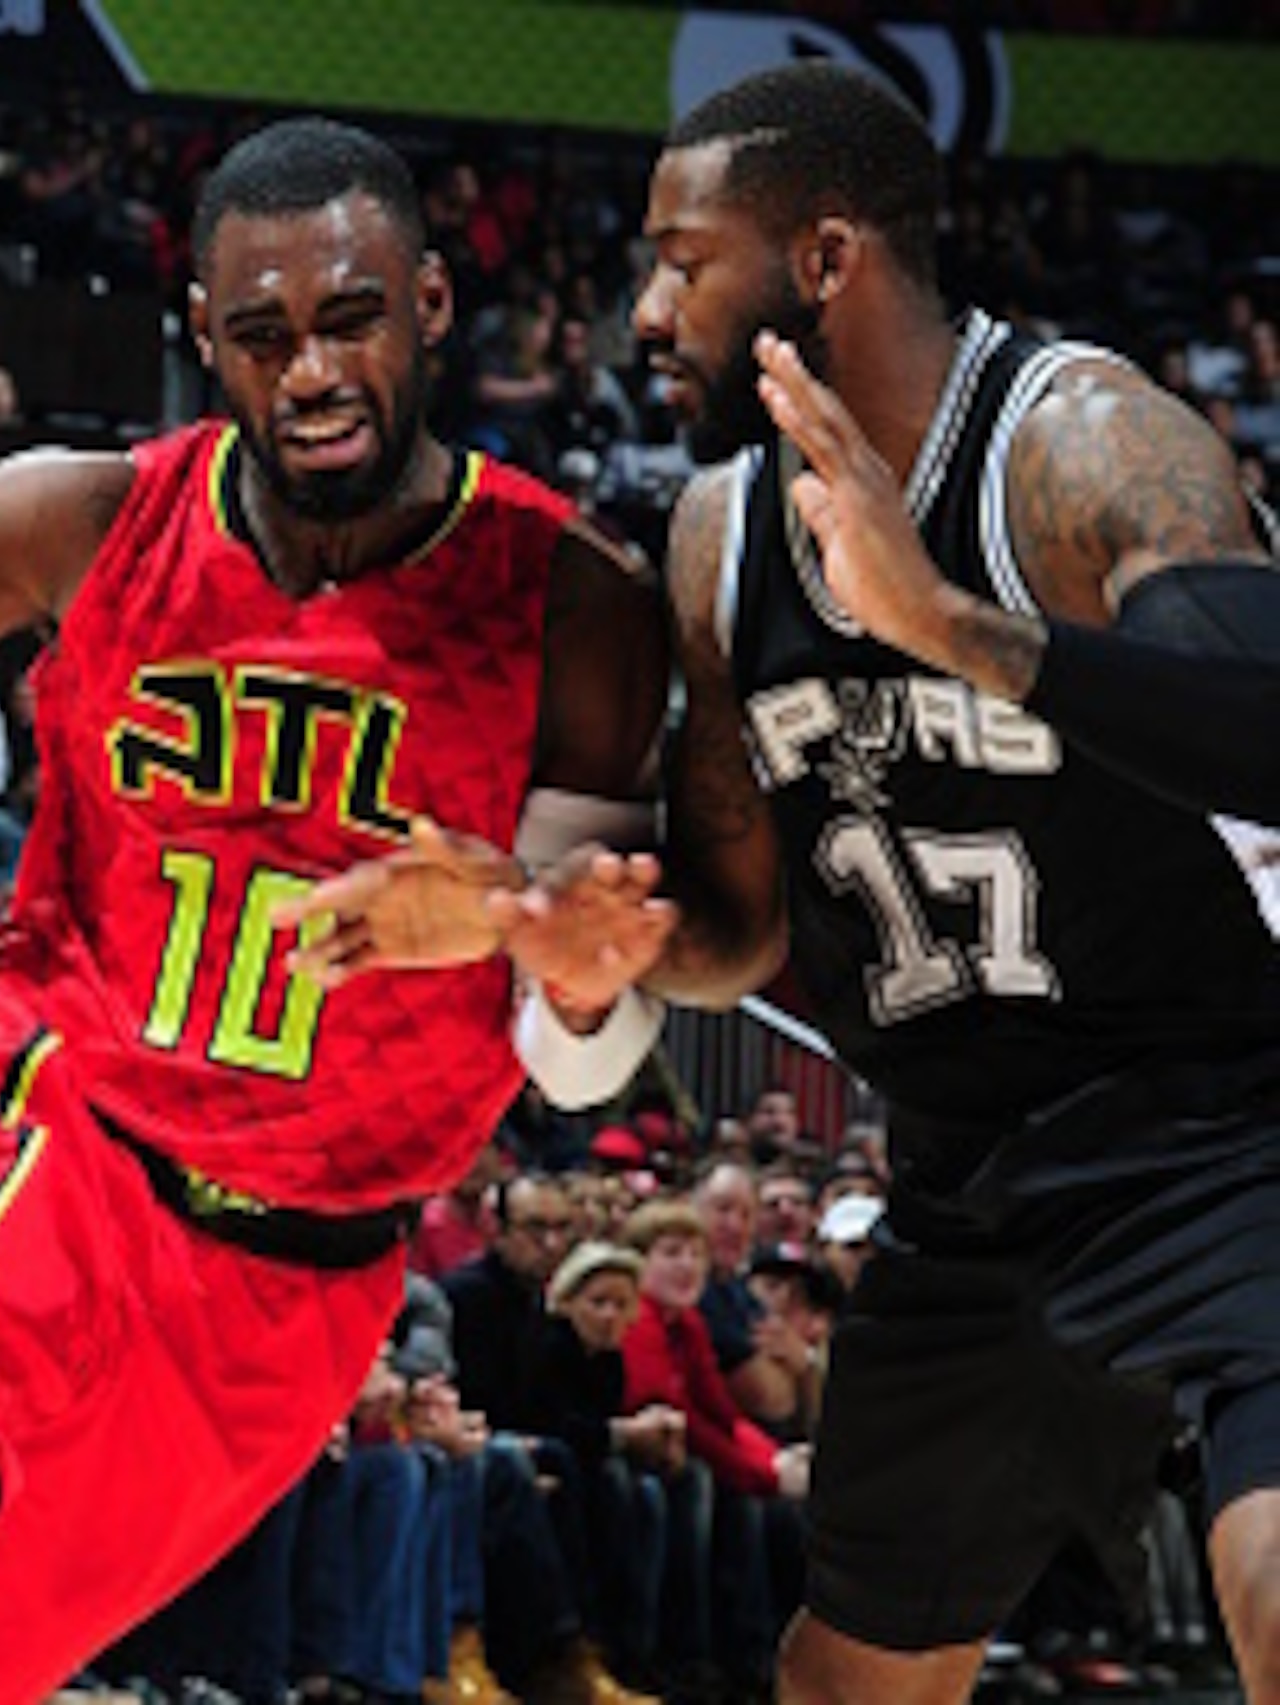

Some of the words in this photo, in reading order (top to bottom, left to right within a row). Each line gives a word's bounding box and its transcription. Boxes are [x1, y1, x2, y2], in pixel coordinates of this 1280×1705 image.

[106, 658, 412, 845] ATL
[740, 673, 1063, 791] PURS
[142, 847, 338, 1081] 10
[812, 813, 1063, 1027] 17
